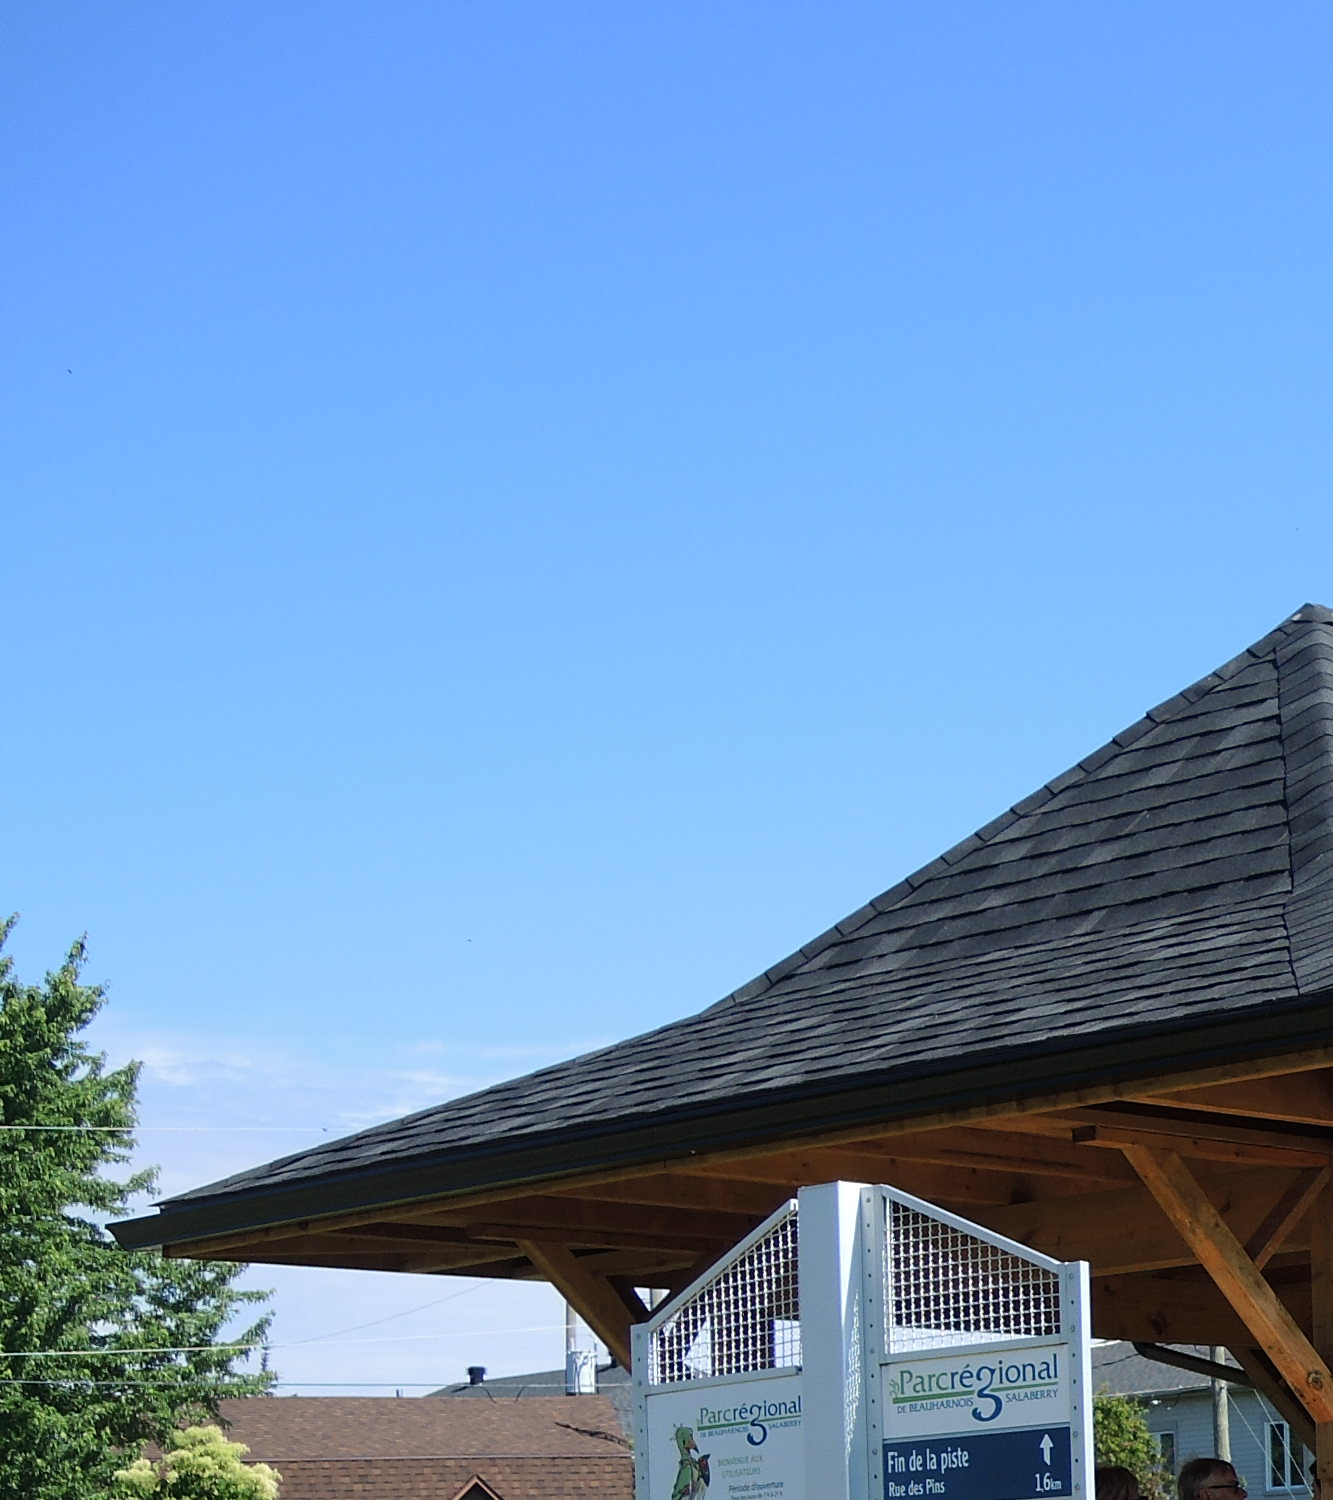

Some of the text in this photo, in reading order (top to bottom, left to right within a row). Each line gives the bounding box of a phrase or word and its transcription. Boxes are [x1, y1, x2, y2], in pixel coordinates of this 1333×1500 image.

[909, 1397, 974, 1413] BEAUHARNOIS
[1005, 1389, 1058, 1403] SALABERRY
[888, 1447, 969, 1474] Fin de la piste
[889, 1478, 945, 1497] Rue des Pins
